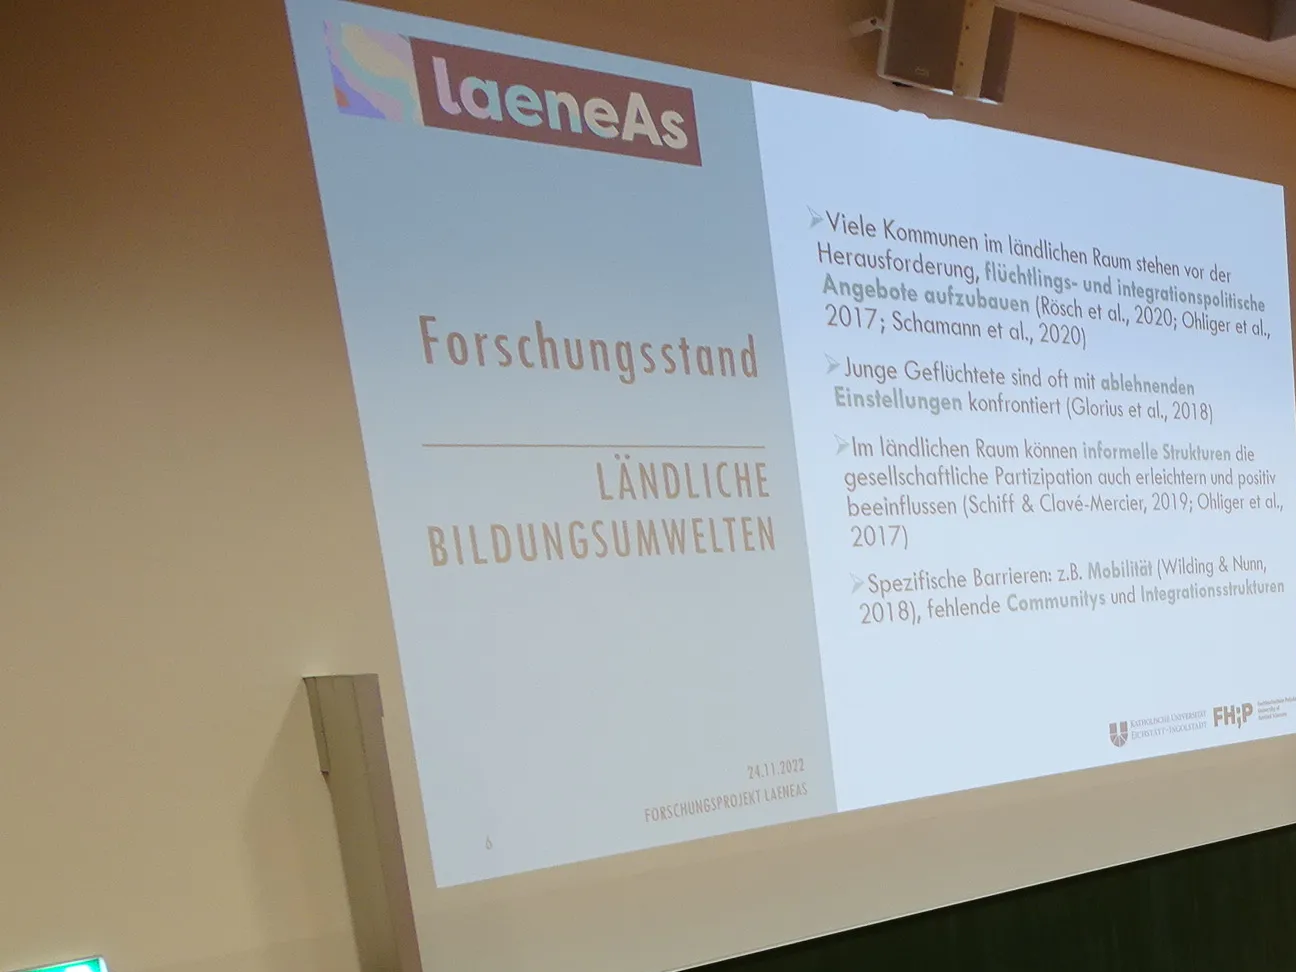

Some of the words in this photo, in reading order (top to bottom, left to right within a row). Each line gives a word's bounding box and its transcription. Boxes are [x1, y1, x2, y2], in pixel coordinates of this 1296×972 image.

[431, 56, 689, 150] laeneAs
[825, 210, 877, 238] Viele
[883, 218, 978, 253] Kommunen
[985, 233, 1002, 254] im
[1008, 236, 1087, 264] ländlichen
[1092, 247, 1131, 270] Raum
[1136, 254, 1180, 278] stehen
[1184, 264, 1204, 280] vor
[1209, 264, 1231, 284] der
[817, 242, 979, 284] Herausforderung,
[984, 260, 1079, 293] flüchtlings-
[1083, 274, 1112, 295] und
[1117, 279, 1265, 313] integrationspolitische
[822, 273, 918, 302] Angebote
[924, 287, 1030, 312] aufzubauen
[1035, 294, 1082, 320] (Rösch
[1088, 302, 1101, 320] et
[1107, 302, 1129, 325] al.,
[1135, 306, 1177, 329] 2020;
[1182, 310, 1231, 336] Ohliger
[1236, 318, 1248, 334] et
[1252, 318, 1271, 339] al.,
[824, 304, 885, 334] 2017;
[892, 310, 981, 338] Schamann
[987, 320, 1004, 339] et
[1009, 321, 1033, 344] al.,
[1039, 323, 1086, 350] 2020)
[419, 315, 759, 384] Forschungsstand
[843, 356, 897, 384] Junge
[904, 359, 1005, 387] Geflüchtete
[1011, 366, 1042, 388] sind
[1047, 368, 1068, 389] oft
[1074, 371, 1095, 390] mit
[1101, 372, 1195, 395] ablehnenden
[835, 386, 962, 414] Einstellungen
[969, 390, 1061, 416] konfrontiert
[1066, 396, 1123, 419] (Glorius
[1128, 401, 1142, 418] et
[1146, 401, 1167, 422] al.,
[1172, 401, 1214, 424] 2018)
[852, 435, 873, 458] Im
[880, 437, 969, 458] ländlichen
[976, 439, 1019, 458] Raum
[1025, 439, 1077, 459] können
[1082, 441, 1158, 460] informelle
[1163, 442, 1231, 462] Strukturen
[1235, 443, 1255, 462] die
[595, 453, 770, 501] LÄNDLICHE
[844, 465, 988, 492] gesellschaftliche
[995, 467, 1092, 490] Partizipation
[1097, 468, 1131, 486] auch
[1136, 468, 1206, 486] erleichtern
[1210, 468, 1233, 485] und
[1238, 468, 1276, 488] positiv
[847, 495, 956, 517] beeinflussen
[962, 494, 1014, 519] (Schiff
[1022, 496, 1034, 513] &
[1039, 493, 1147, 514] Clavé-Mercier,
[1152, 493, 1193, 514] 2019;
[1197, 492, 1244, 513] Ohliger
[1250, 495, 1261, 509] et
[1265, 493, 1284, 512] al.,
[427, 516, 776, 567] BILDUNGSUMWELTEN
[851, 524, 908, 550] 2017)
[867, 568, 966, 595] Spezifische
[973, 566, 1052, 587] Barrieren:
[1057, 563, 1082, 582] z.B.
[1087, 559, 1152, 579] Mobilität
[1157, 557, 1214, 579] (Wilding
[1219, 557, 1229, 572] &
[1233, 556, 1267, 574] Nunn,
[860, 600, 920, 625] 2018),
[926, 597, 1000, 619] fehlende
[1007, 591, 1106, 612] Communitys
[1110, 588, 1136, 605] und
[1141, 579, 1285, 602] Integrationsstrukturen
[748, 758, 804, 779] 24.11.2022
[645, 789, 761, 822] FORSCHUNGSPROJEKT
[764, 782, 808, 802] LAENEAS
